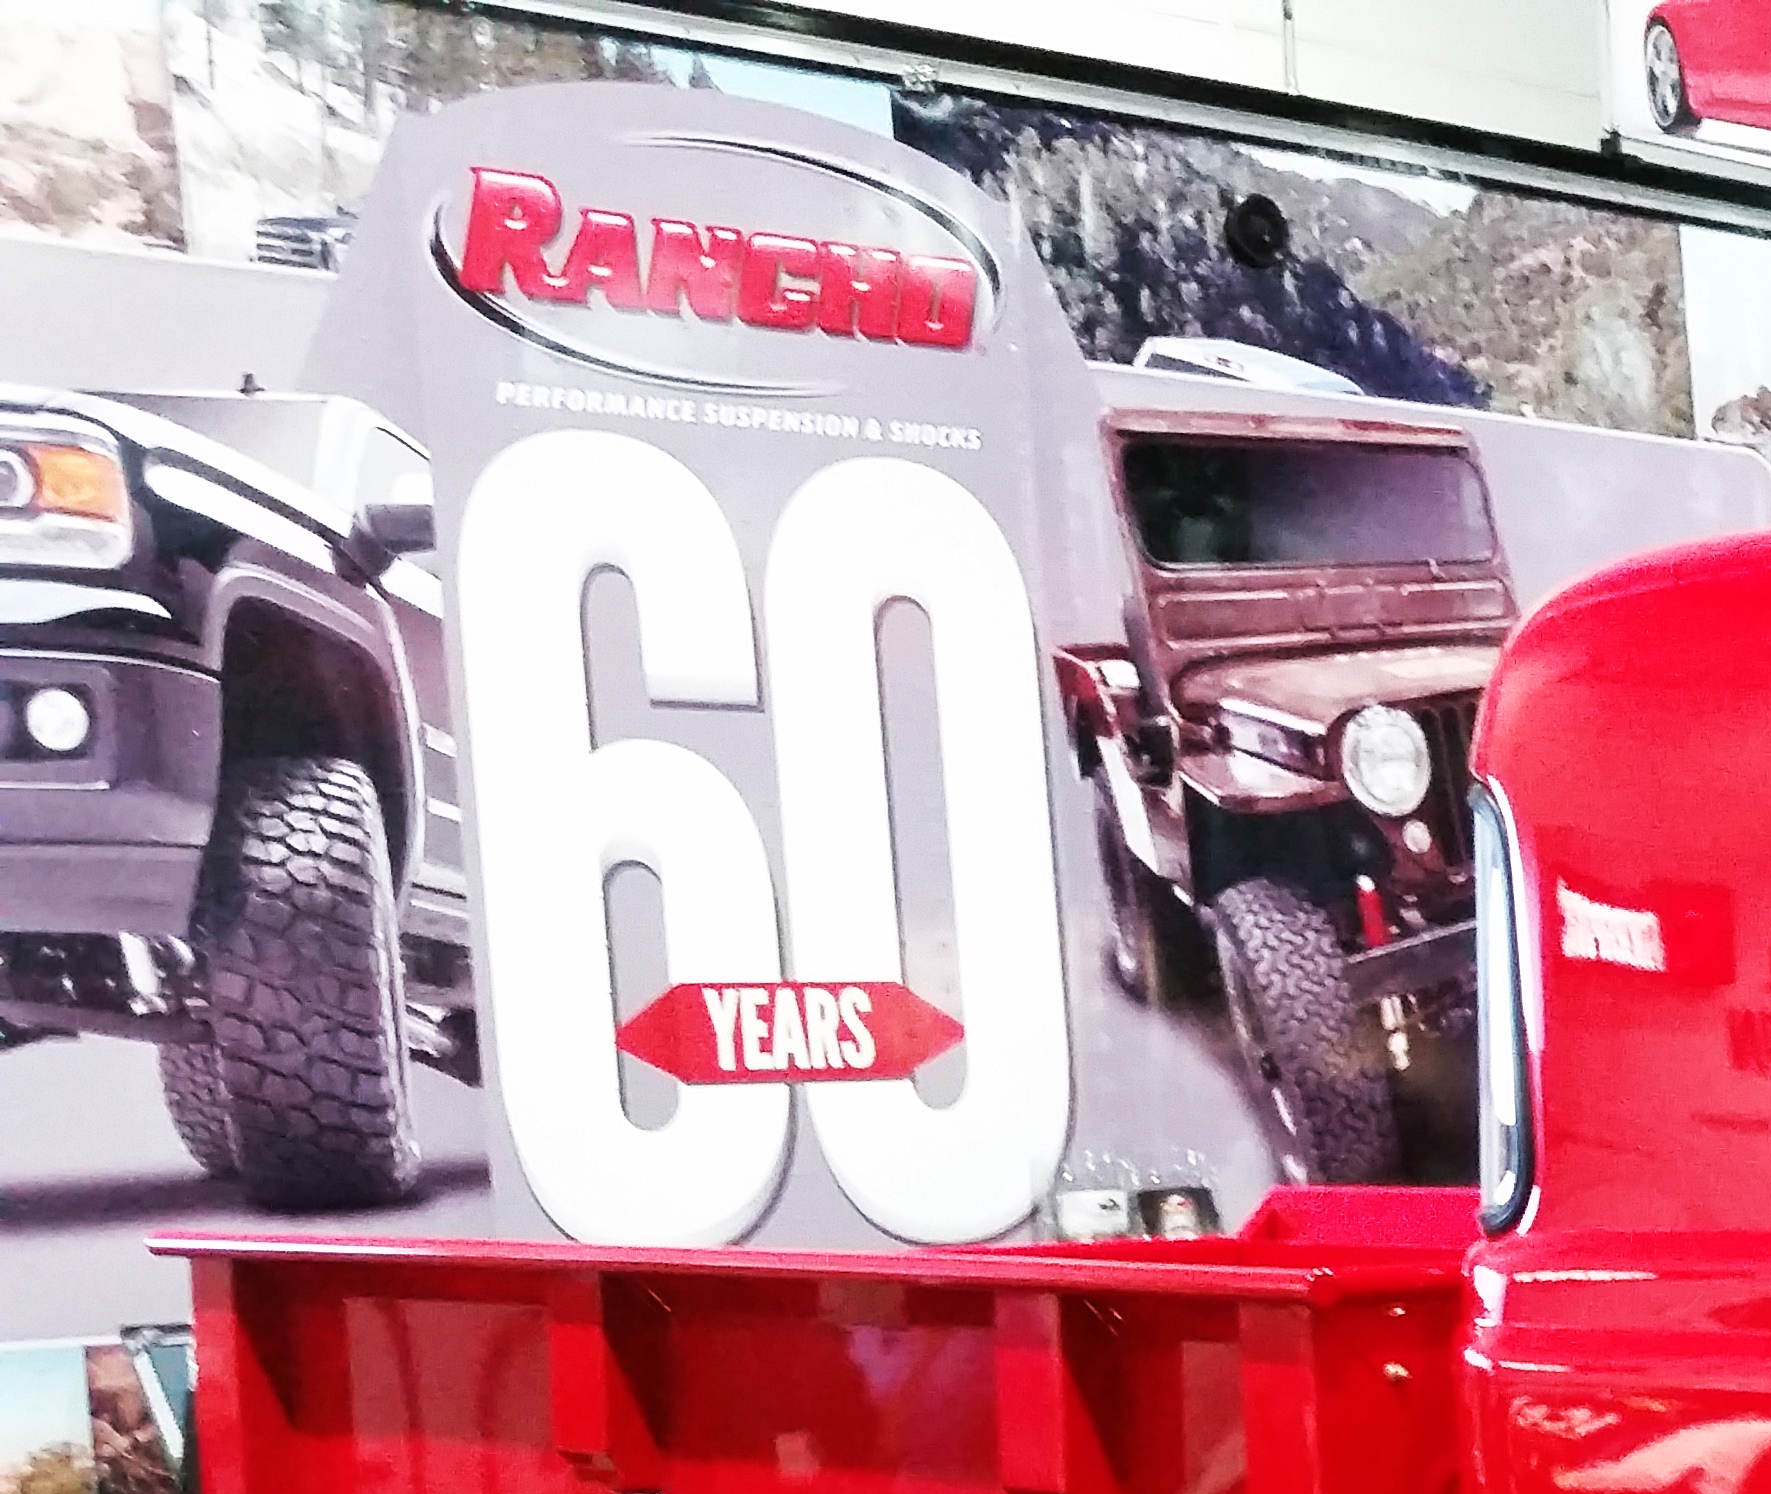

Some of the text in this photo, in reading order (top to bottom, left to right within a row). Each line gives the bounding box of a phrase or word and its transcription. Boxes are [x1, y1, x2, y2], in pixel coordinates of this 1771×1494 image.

[457, 166, 978, 350] RANCHO
[495, 381, 983, 450] PERFORMANCE SUSPENSION & SHOCKS
[457, 429, 1072, 1244] 60
[702, 987, 876, 1072] YEARS
